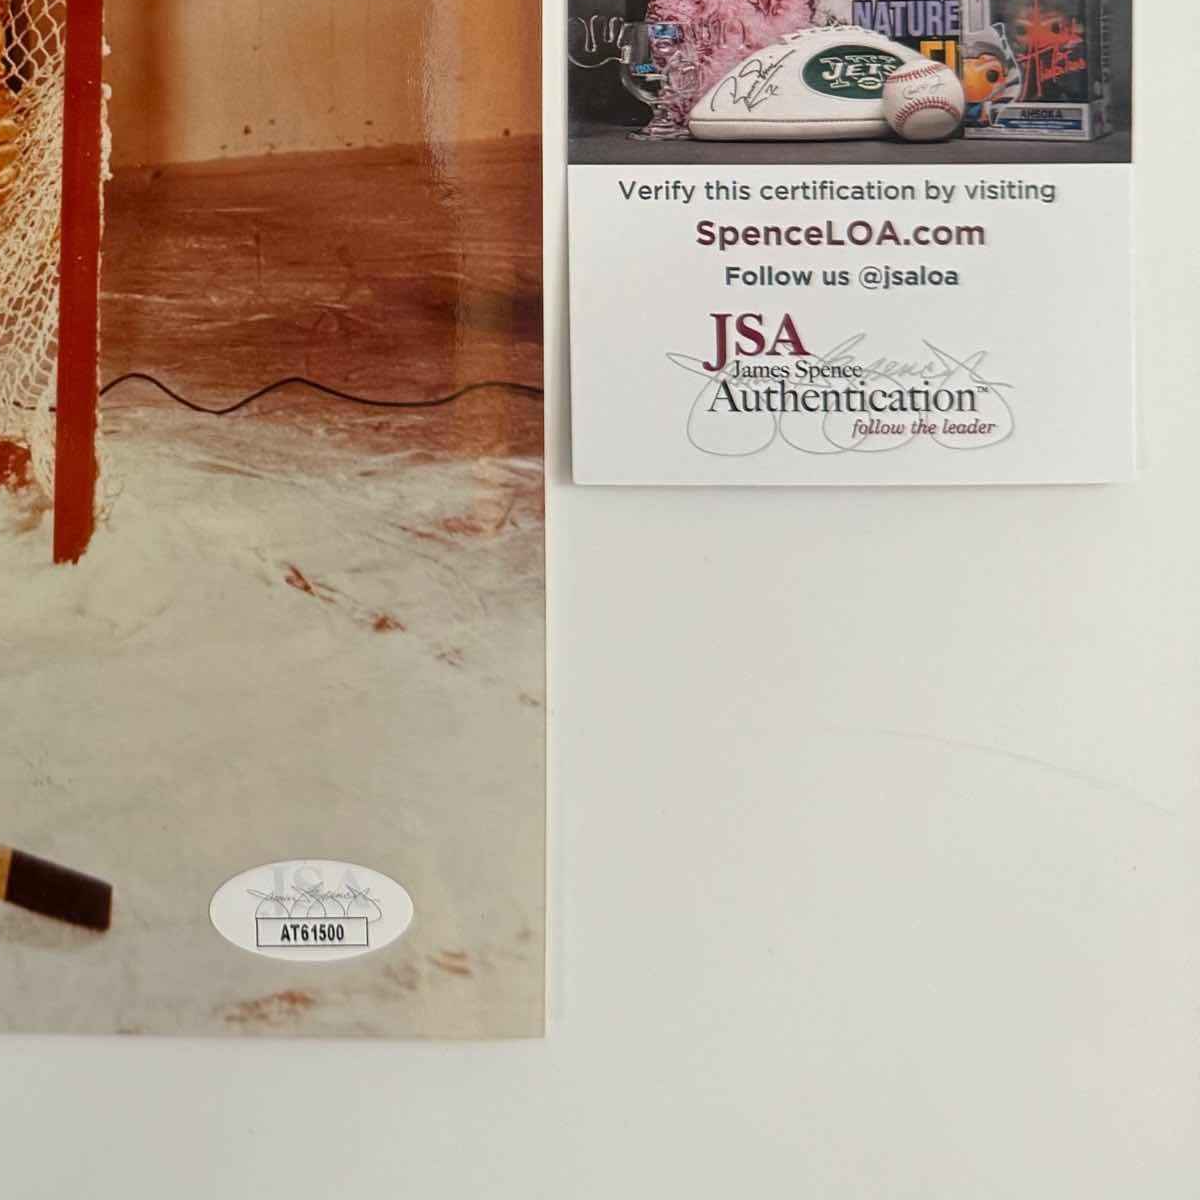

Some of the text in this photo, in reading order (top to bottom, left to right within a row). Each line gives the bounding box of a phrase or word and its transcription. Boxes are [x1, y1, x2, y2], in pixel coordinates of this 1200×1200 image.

[853, 0, 960, 36] NATURE
[618, 180, 1056, 204] Verify this certification by visiting
[696, 220, 985, 250] SpenceLOA.com
[725, 265, 959, 290] Follow us @jsaloa
[702, 312, 811, 373] JSA
[732, 360, 862, 381] James Spence
[851, 418, 996, 438] follow the leader
[281, 924, 344, 942] AT61500
